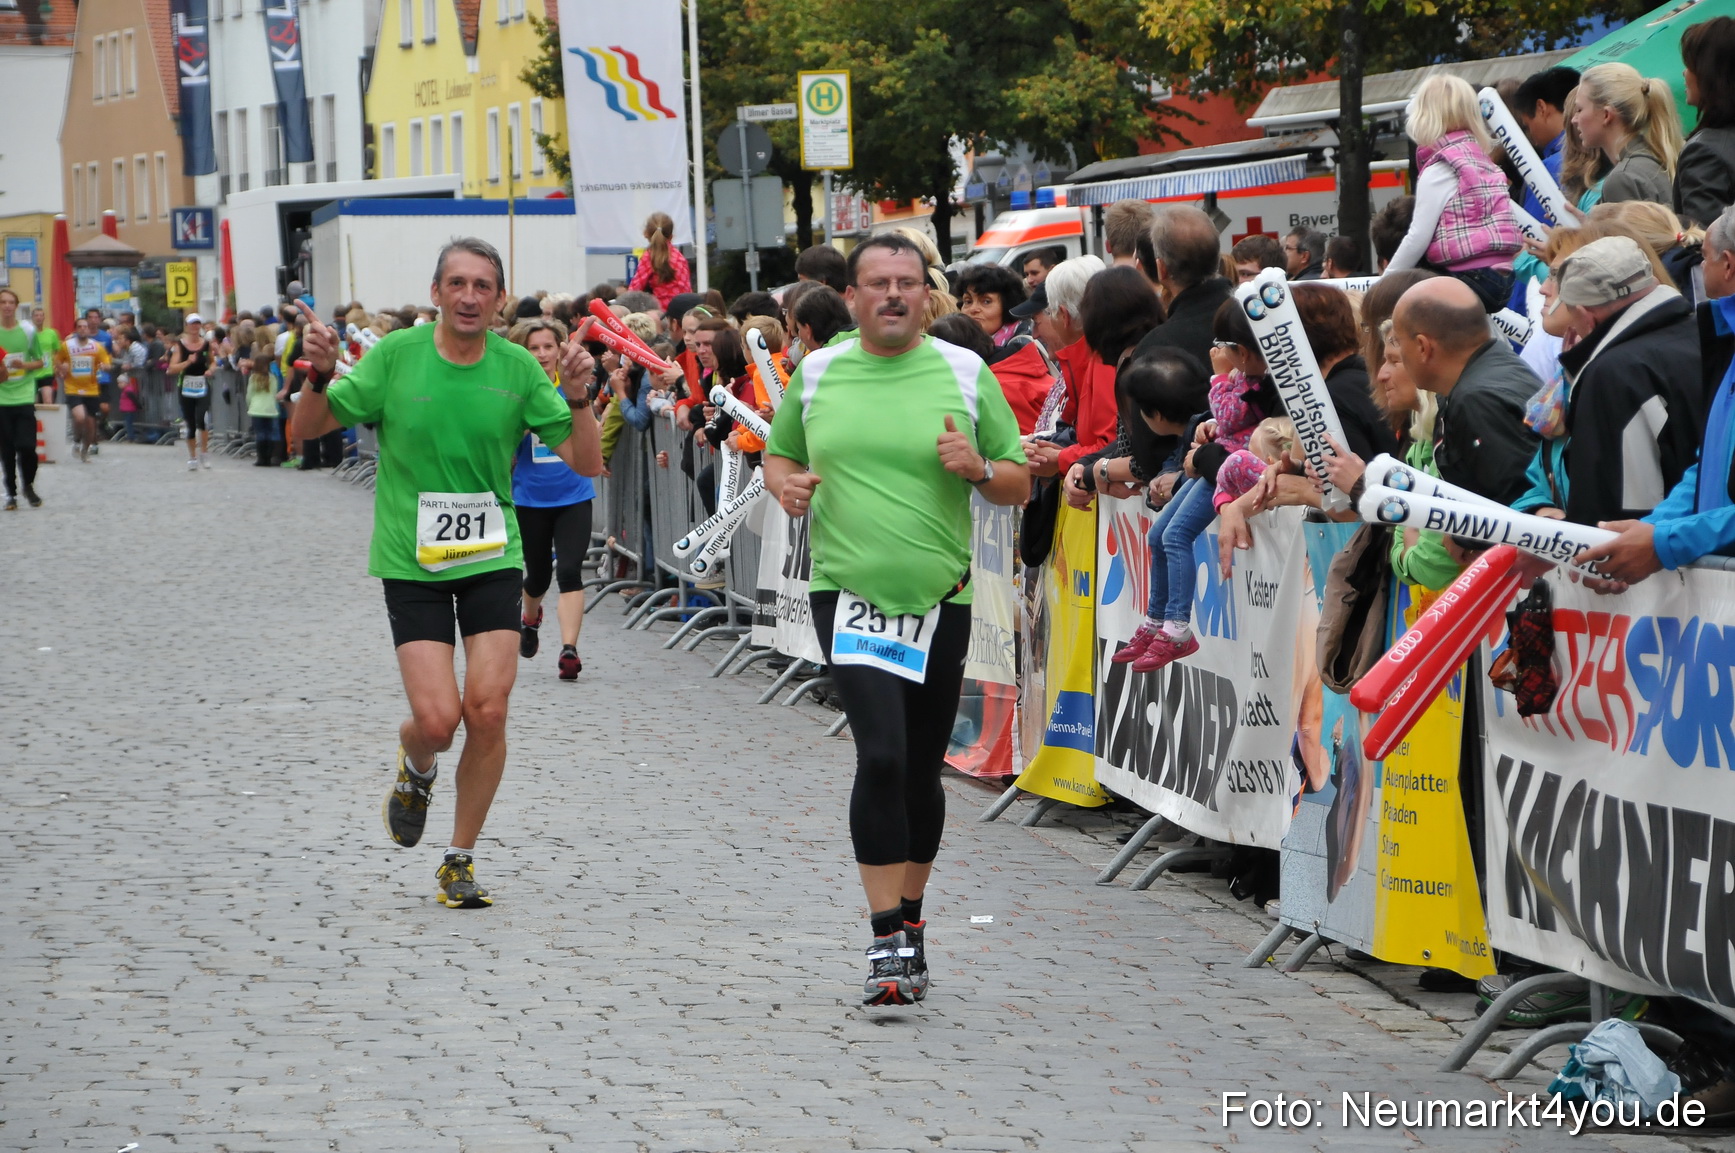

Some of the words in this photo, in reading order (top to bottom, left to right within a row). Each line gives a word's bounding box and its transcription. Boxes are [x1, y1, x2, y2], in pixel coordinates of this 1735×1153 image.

[415, 80, 439, 107] HOTEL
[748, 108, 769, 117] Ulmer
[771, 106, 793, 115] Gasse
[1495, 125, 1527, 173] BMW
[169, 265, 192, 273] Block
[175, 276, 189, 297] D
[1258, 332, 1296, 390] BMW
[420, 500, 450, 509] PARTL
[452, 500, 492, 509] Neumarkt
[435, 512, 486, 541] 281
[695, 511, 724, 537] BMW
[1425, 506, 1500, 540] BMW
[1455, 557, 1490, 592] Audi
[1427, 592, 1460, 623] BKK
[845, 601, 925, 643] 2517
[856, 638, 906, 663] Manfred
